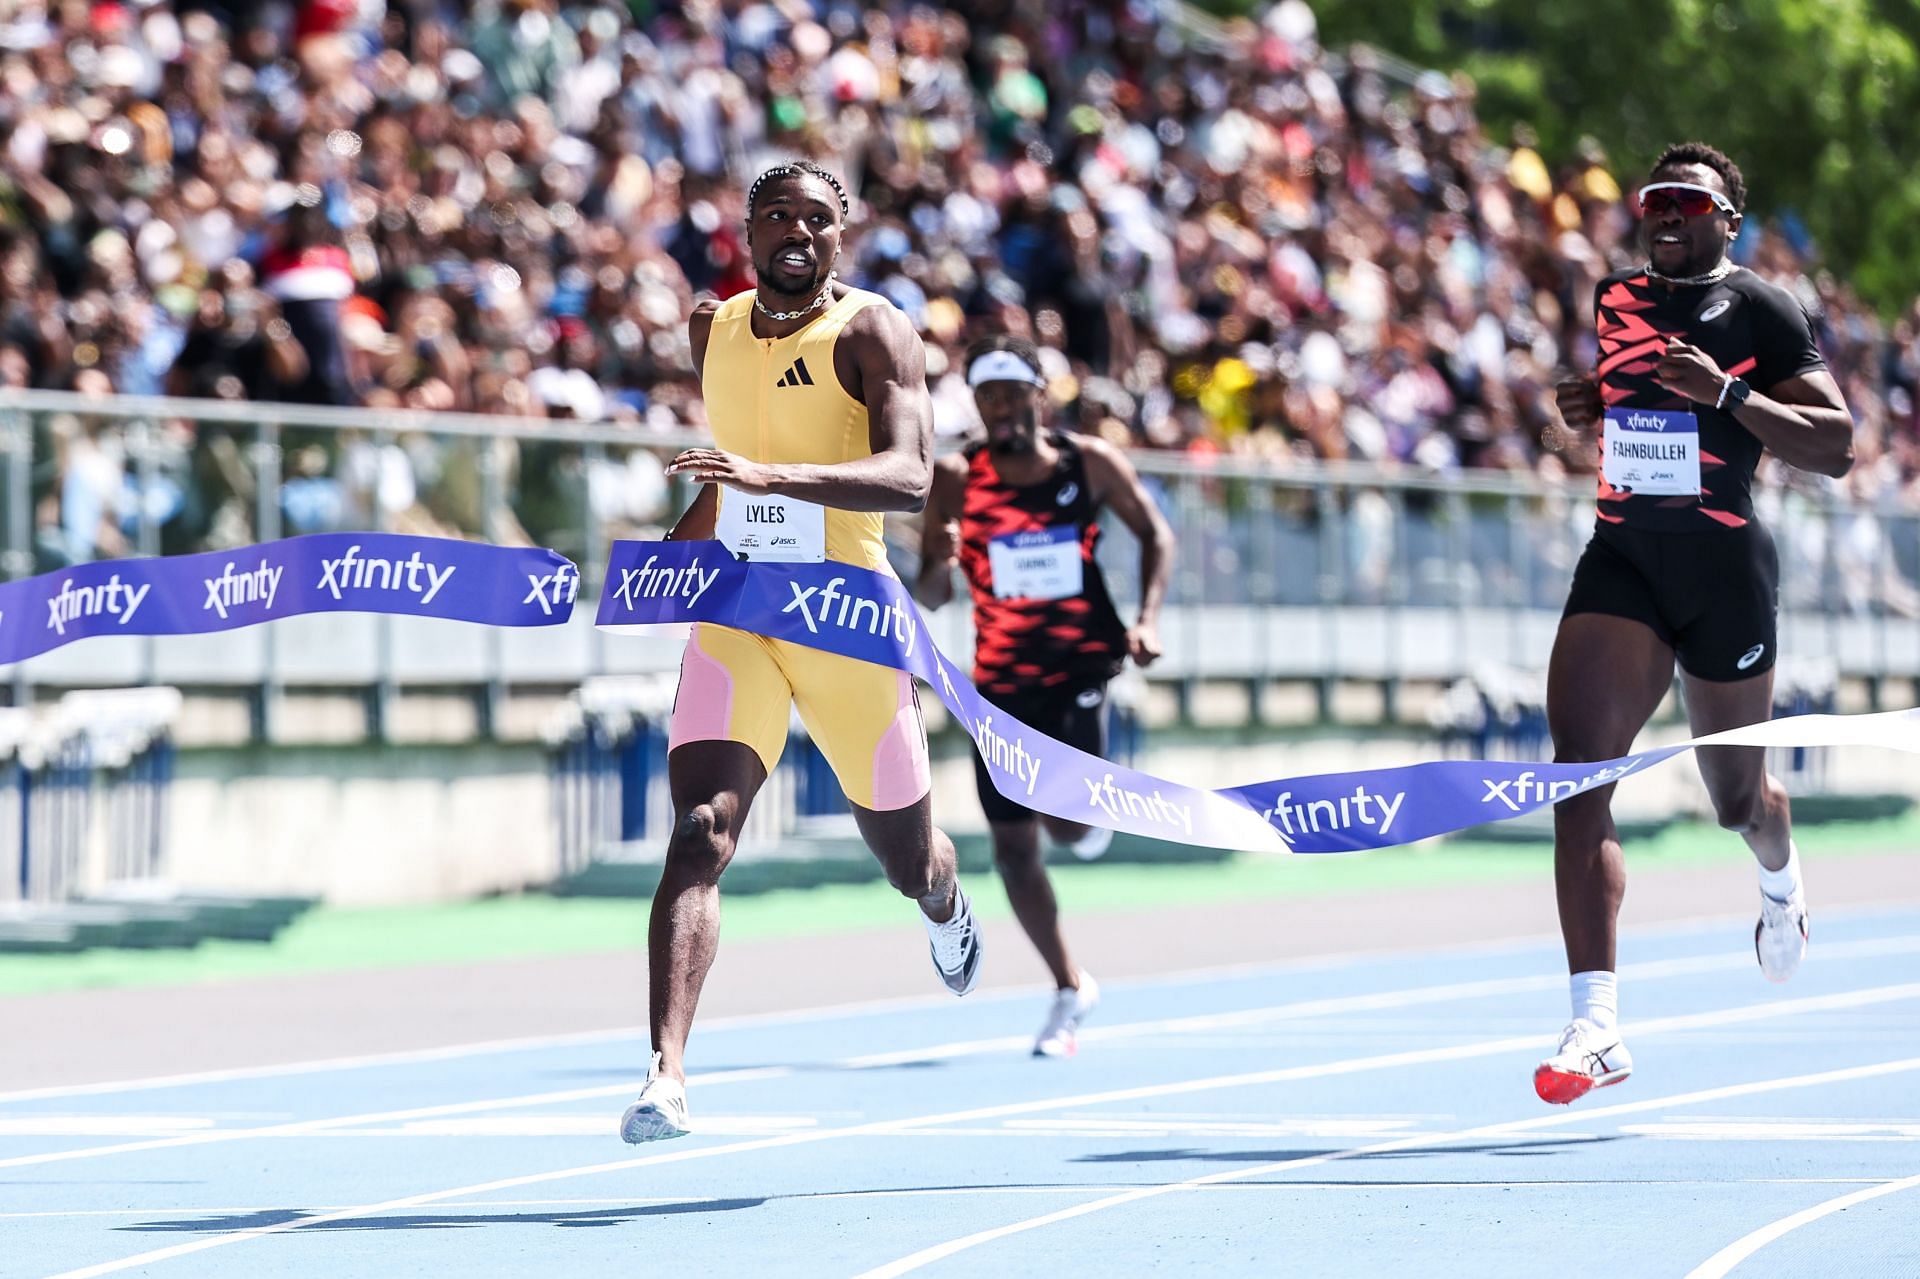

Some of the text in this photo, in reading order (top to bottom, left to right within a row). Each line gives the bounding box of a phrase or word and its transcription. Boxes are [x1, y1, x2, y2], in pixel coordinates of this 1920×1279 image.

[1627, 412, 1667, 432] xfinity
[1613, 440, 1686, 461] FAHNBULLEH
[746, 504, 785, 524] LYLES
[778, 537, 797, 545] asics
[47, 574, 151, 635] xfinity
[203, 558, 284, 619] xfinity
[317, 545, 457, 604] xfinity
[612, 555, 720, 611] xfinity
[782, 576, 917, 658] xfinity
[973, 715, 1042, 796] xfinity
[1084, 773, 1194, 836] xfinity
